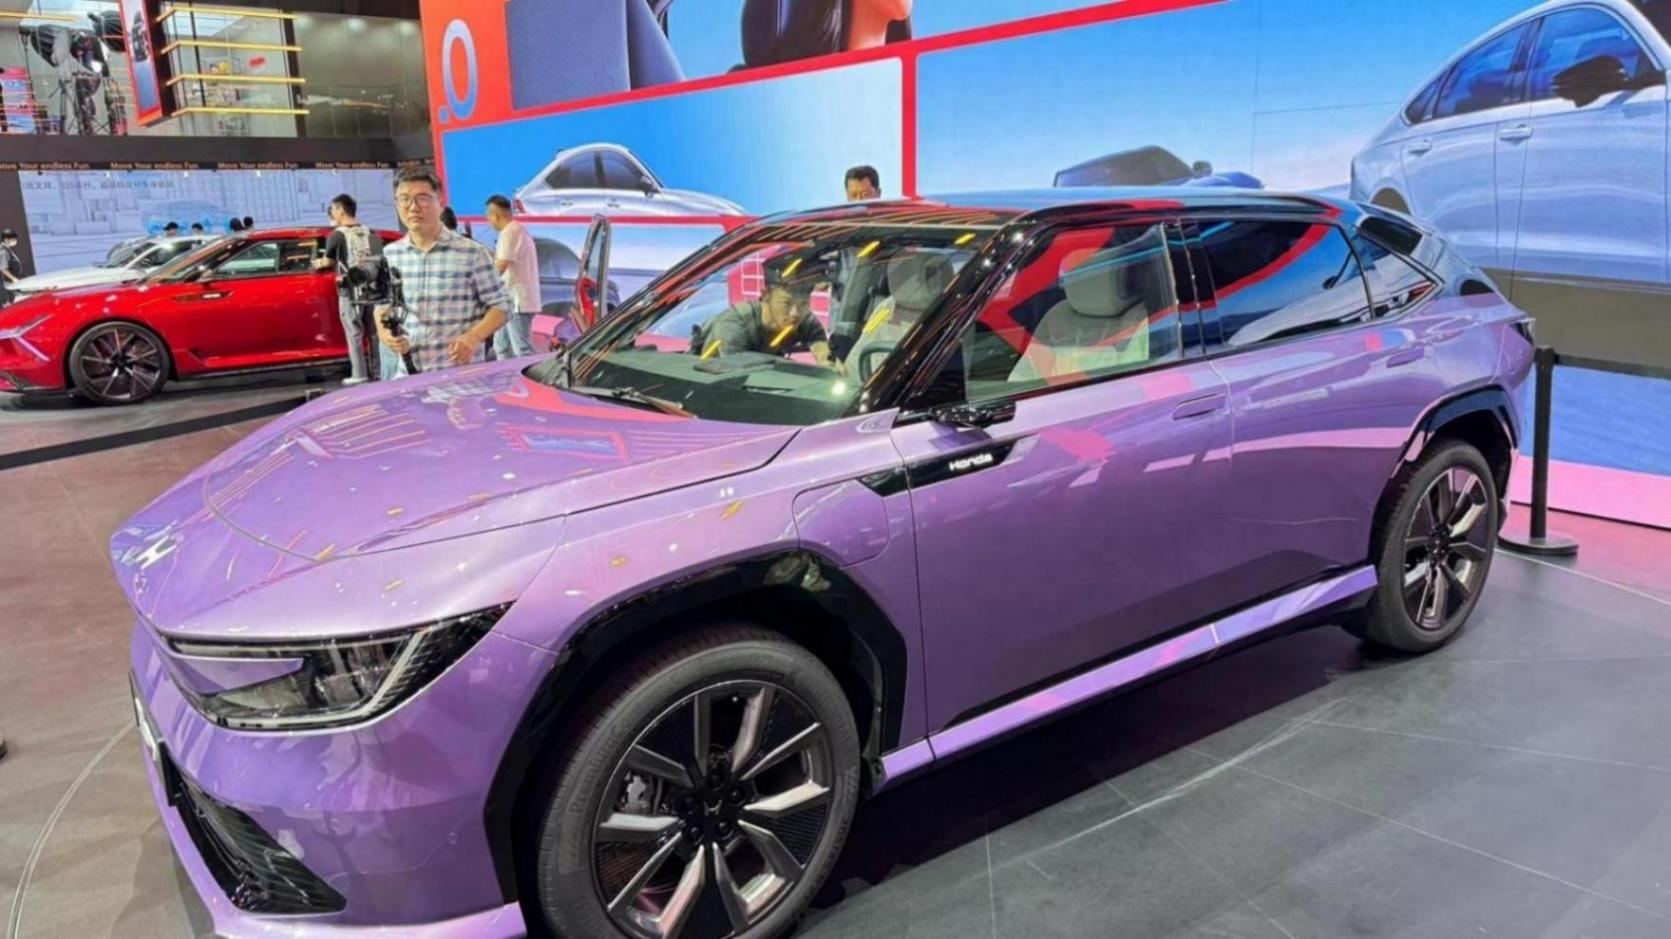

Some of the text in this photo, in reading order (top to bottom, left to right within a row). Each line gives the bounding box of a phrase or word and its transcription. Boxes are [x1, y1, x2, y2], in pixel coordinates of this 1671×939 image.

[19, 162, 38, 170] Your
[40, 161, 72, 170] endless
[73, 161, 90, 170] Fun
[110, 161, 133, 169] Move
[153, 161, 183, 169] endless
[184, 161, 199, 169] Fun
[217, 161, 299, 169] Move Your endless Fun
[949, 453, 993, 471] Honda
